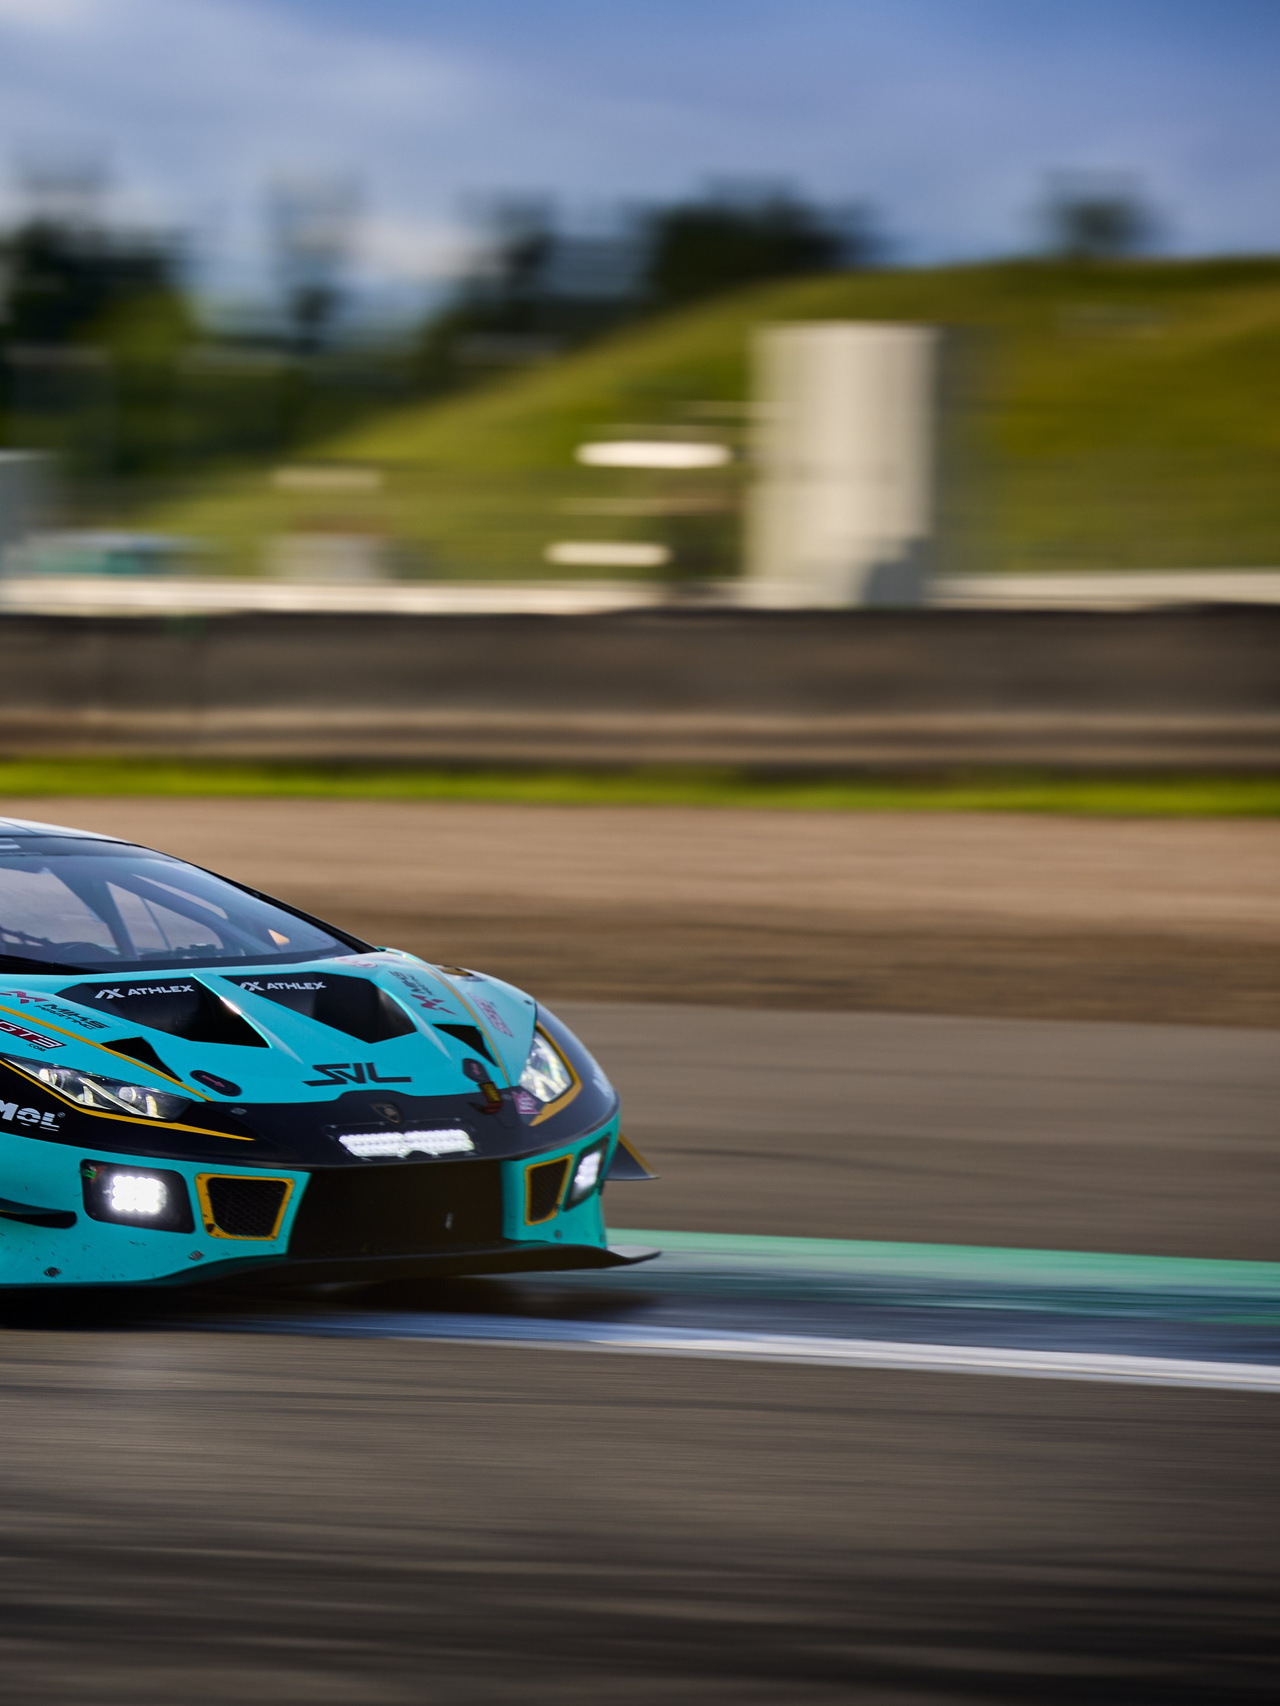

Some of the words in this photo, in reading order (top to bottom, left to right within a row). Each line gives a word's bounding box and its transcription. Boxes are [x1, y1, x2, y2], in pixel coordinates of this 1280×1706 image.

[128, 985, 196, 996] ATHLEX
[267, 981, 327, 991] ATHLEX
[302, 1062, 412, 1087] SVL
